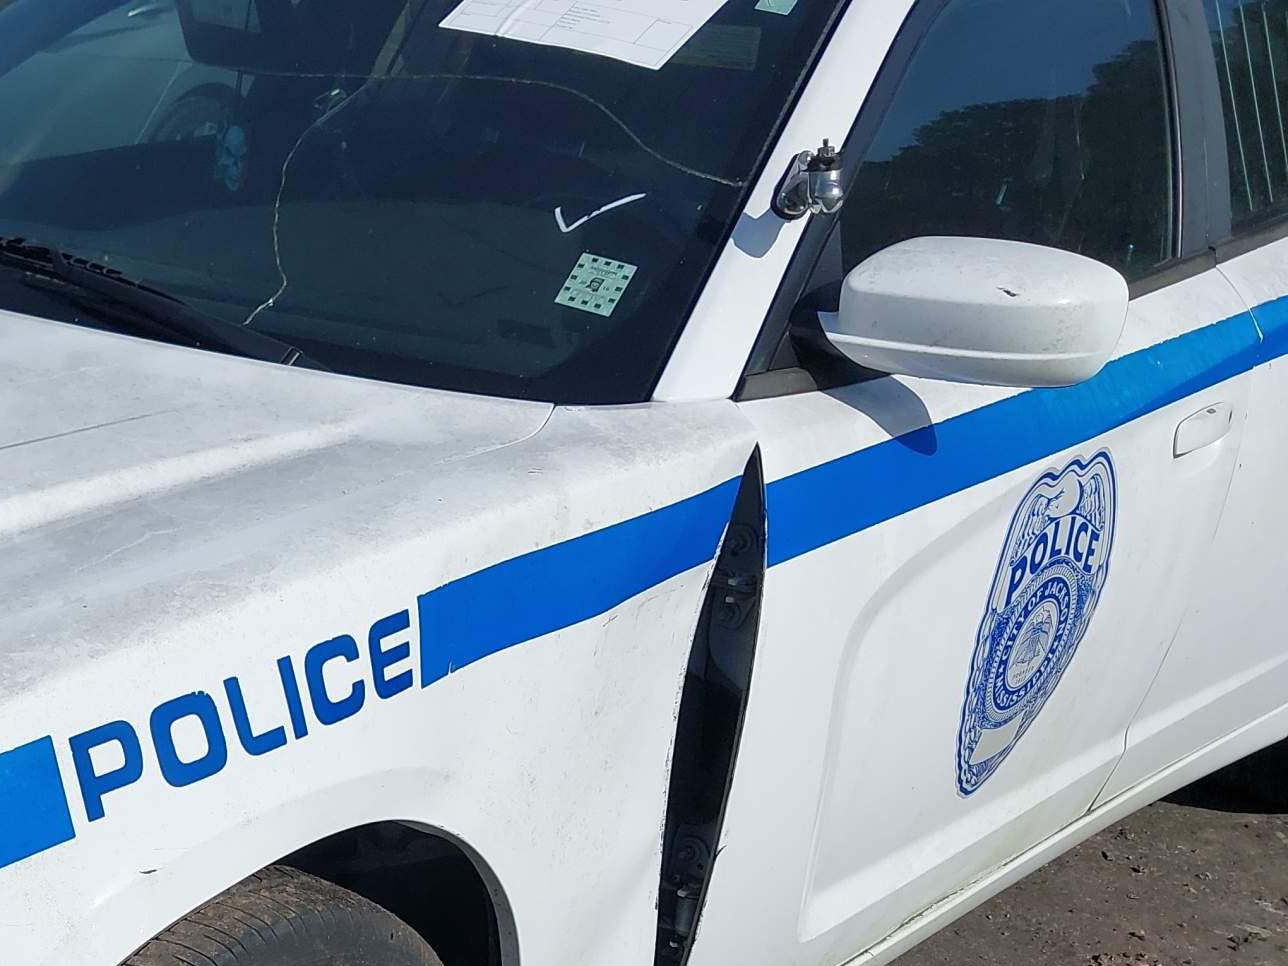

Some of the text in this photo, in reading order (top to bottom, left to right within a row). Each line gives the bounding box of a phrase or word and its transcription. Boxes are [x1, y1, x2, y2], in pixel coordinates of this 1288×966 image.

[1005, 516, 1100, 608] POLICE
[1002, 580, 1068, 660] CITY OF JACKSON
[68, 608, 414, 823] POLICE
[995, 653, 1053, 707] MISSISSIPPI
